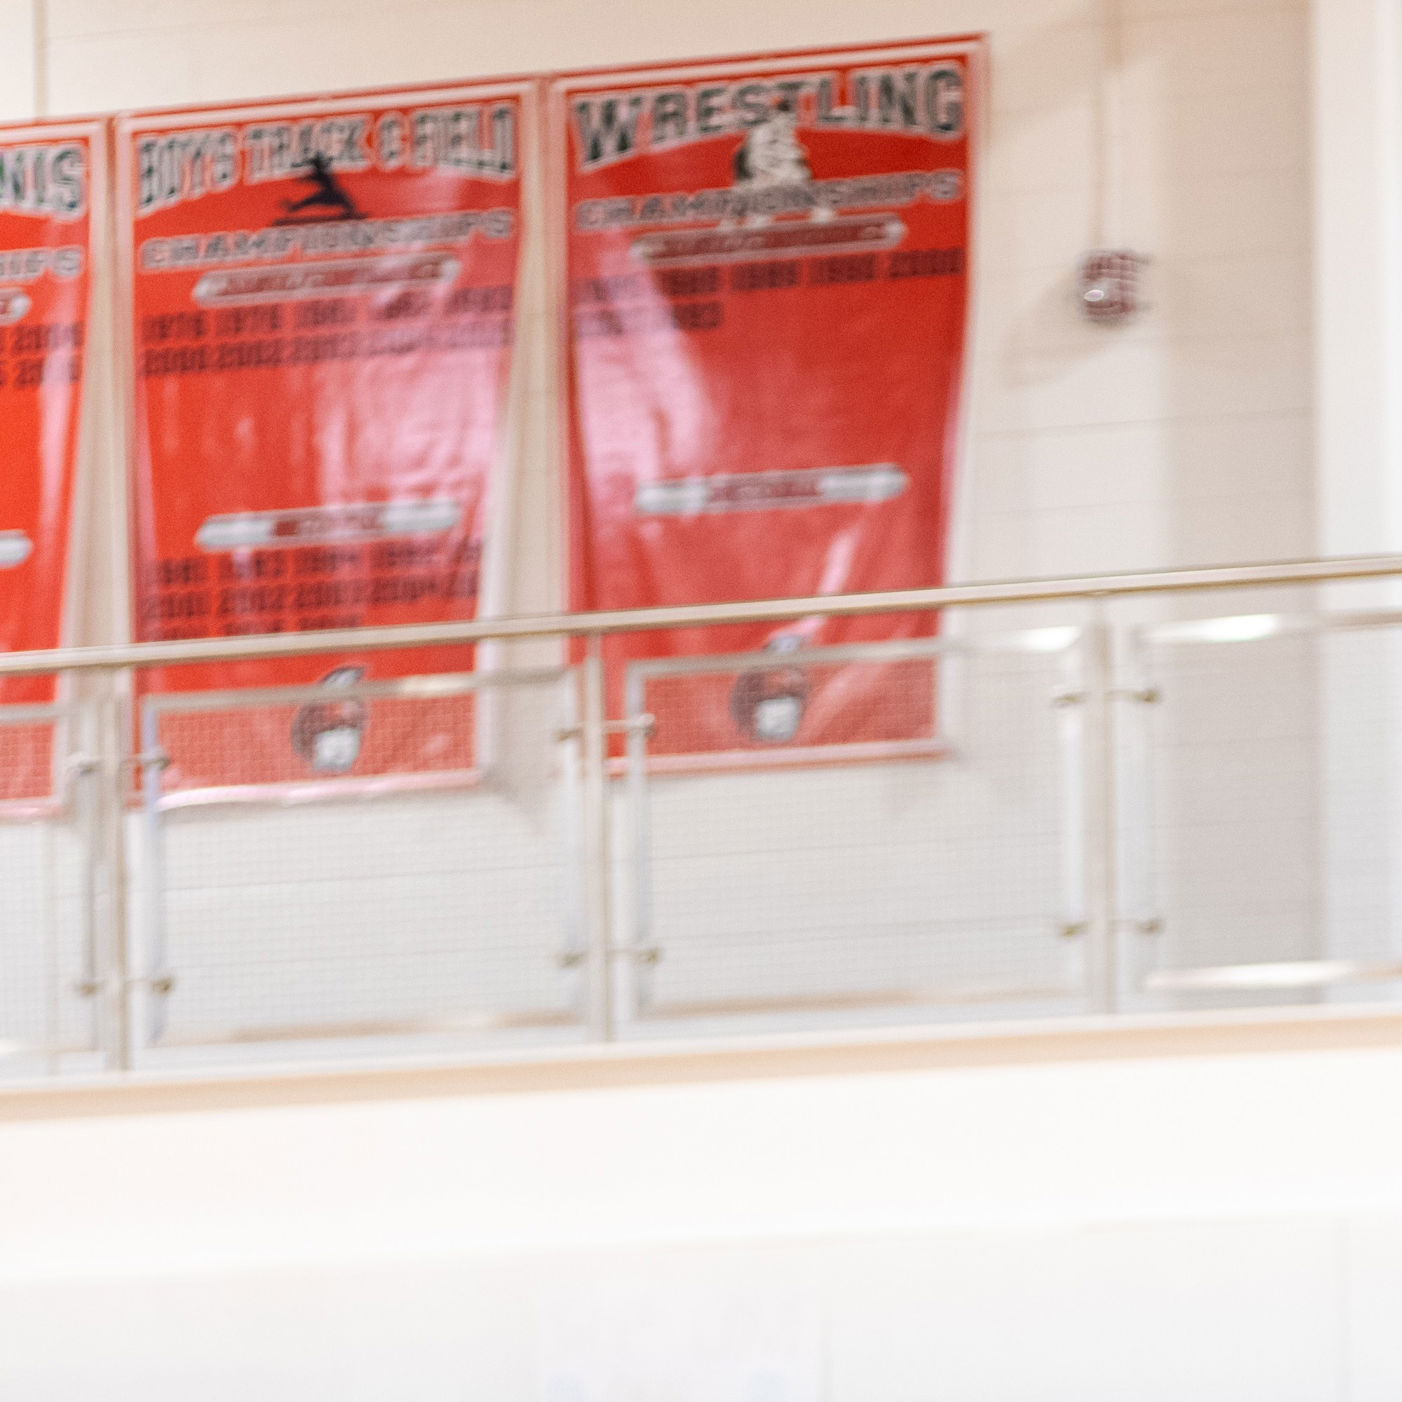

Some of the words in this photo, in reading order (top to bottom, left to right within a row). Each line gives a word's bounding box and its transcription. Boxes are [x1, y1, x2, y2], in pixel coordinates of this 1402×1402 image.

[138, 128, 237, 216] BOYS
[241, 116, 373, 184] TRACK
[411, 103, 516, 181] FIELD
[572, 62, 963, 172] WRESTLING
[140, 208, 514, 271] CHAMPIONSHIPS
[573, 169, 963, 233] CHAMPIONSHIPS
